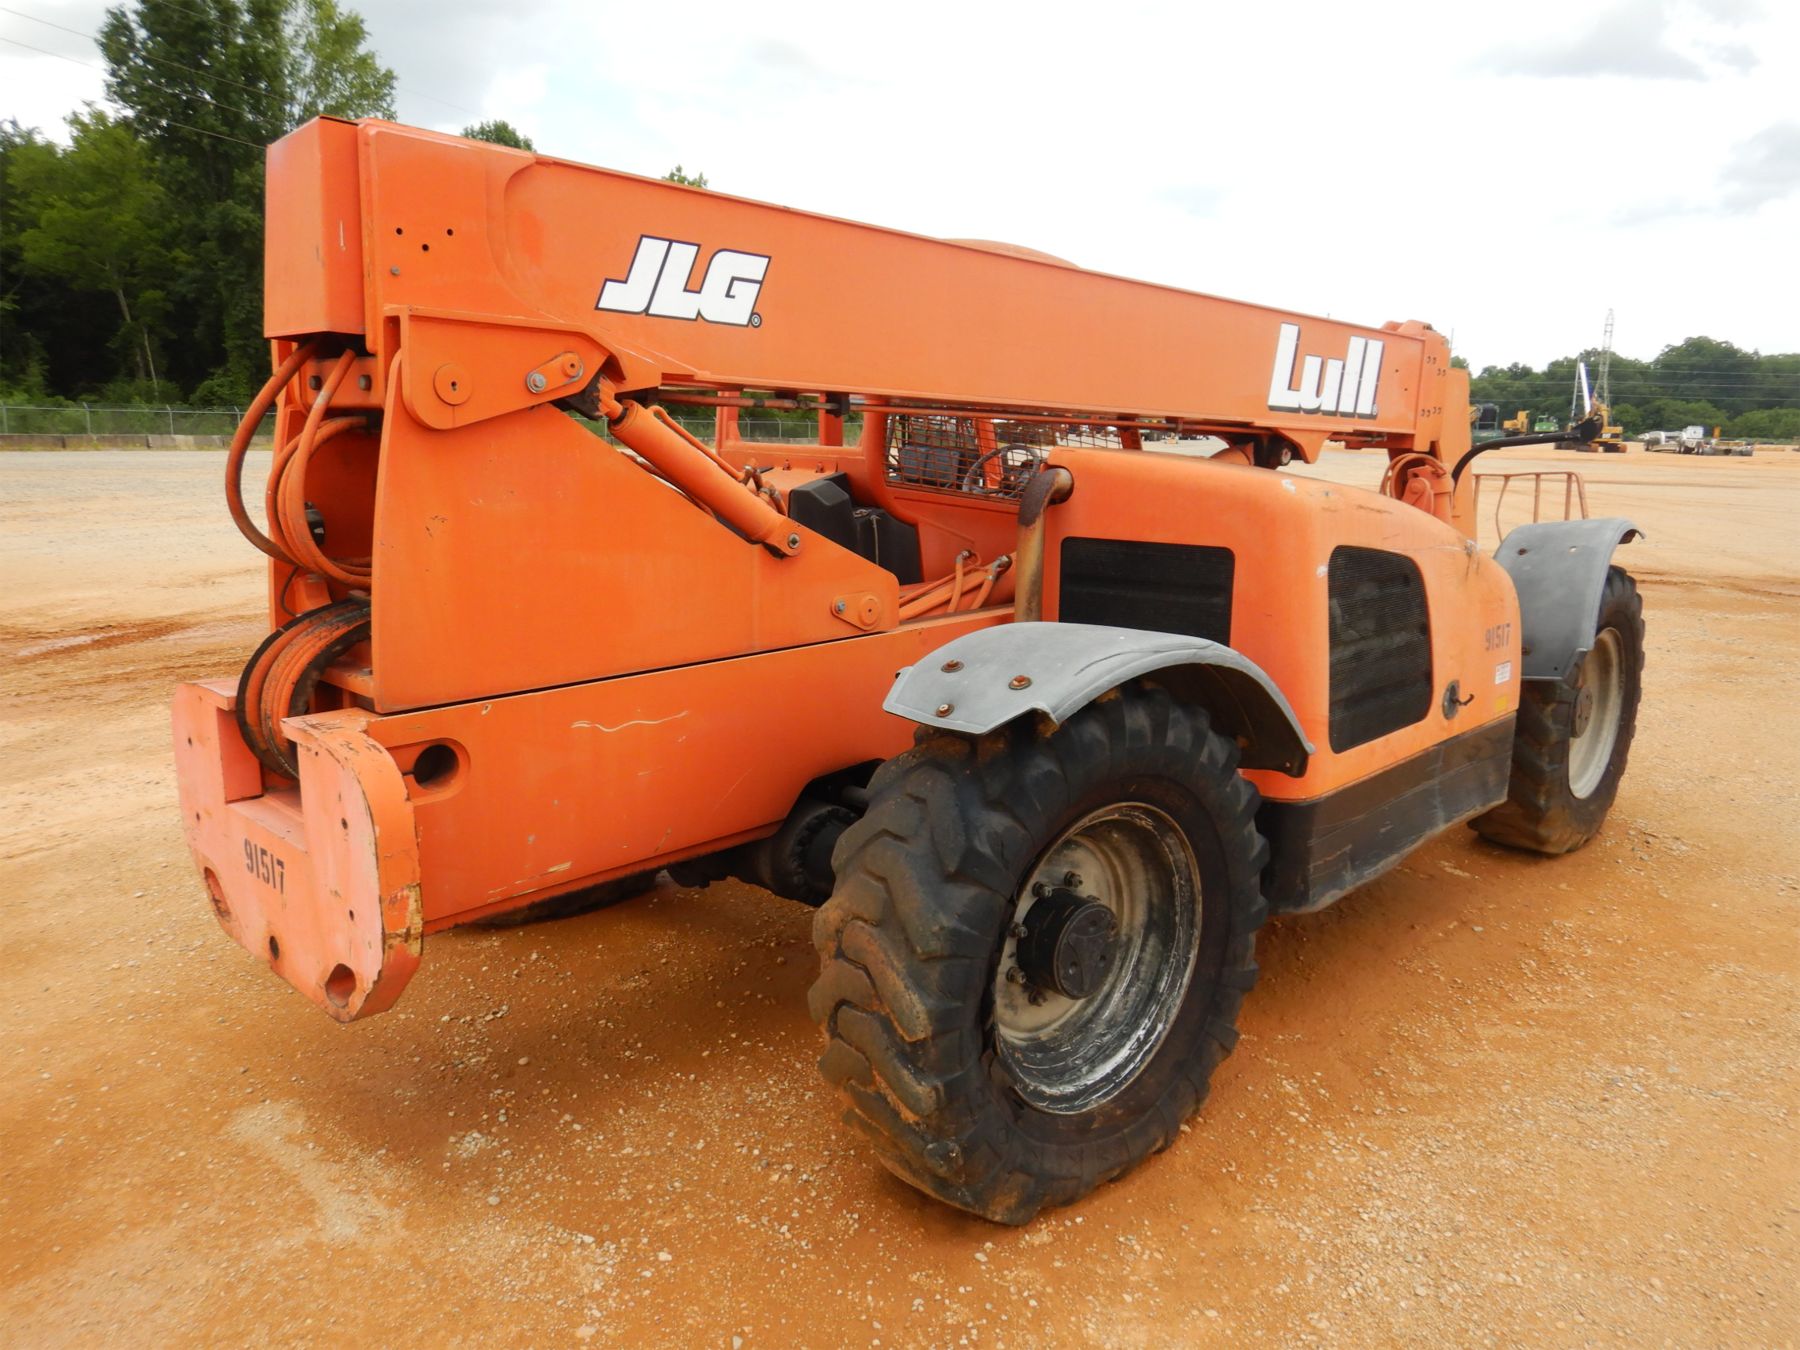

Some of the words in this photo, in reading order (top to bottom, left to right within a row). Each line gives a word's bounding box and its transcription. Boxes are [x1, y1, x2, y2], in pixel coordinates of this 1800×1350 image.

[594, 234, 772, 327] JLG
[1267, 322, 1384, 420] Lull
[1485, 623, 1511, 652] 91517
[244, 838, 285, 895] 91517
